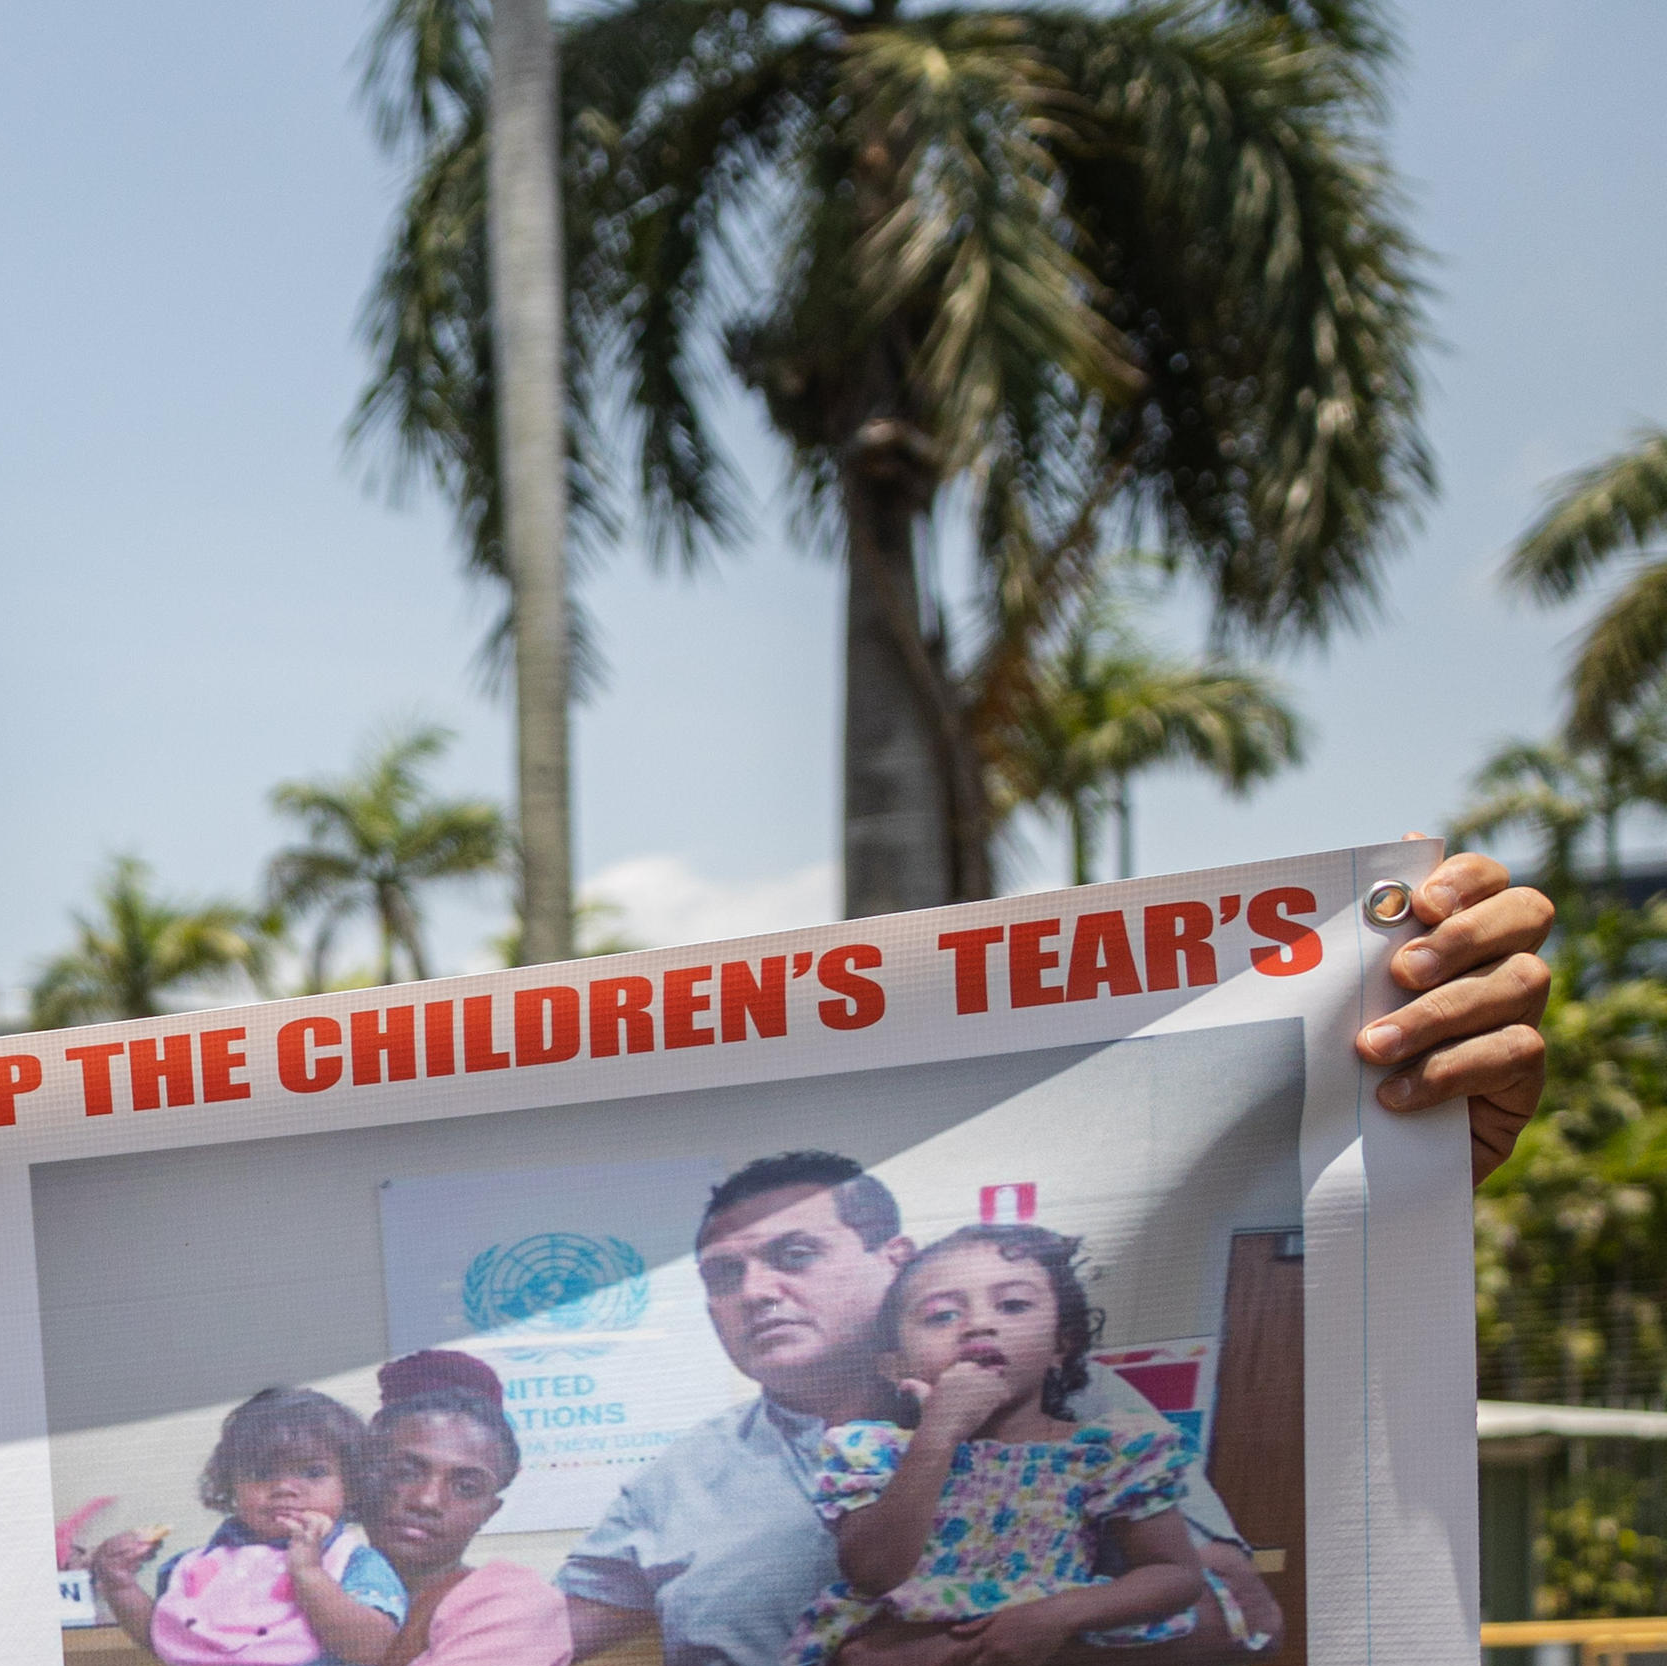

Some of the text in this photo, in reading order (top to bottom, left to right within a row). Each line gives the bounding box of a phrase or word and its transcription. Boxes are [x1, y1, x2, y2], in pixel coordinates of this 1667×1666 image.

[64, 1025, 252, 1117] THE
[276, 943, 886, 1094] CHILDREN'S
[937, 887, 1324, 1014] TEAR'S
[504, 1374, 595, 1400] NITED
